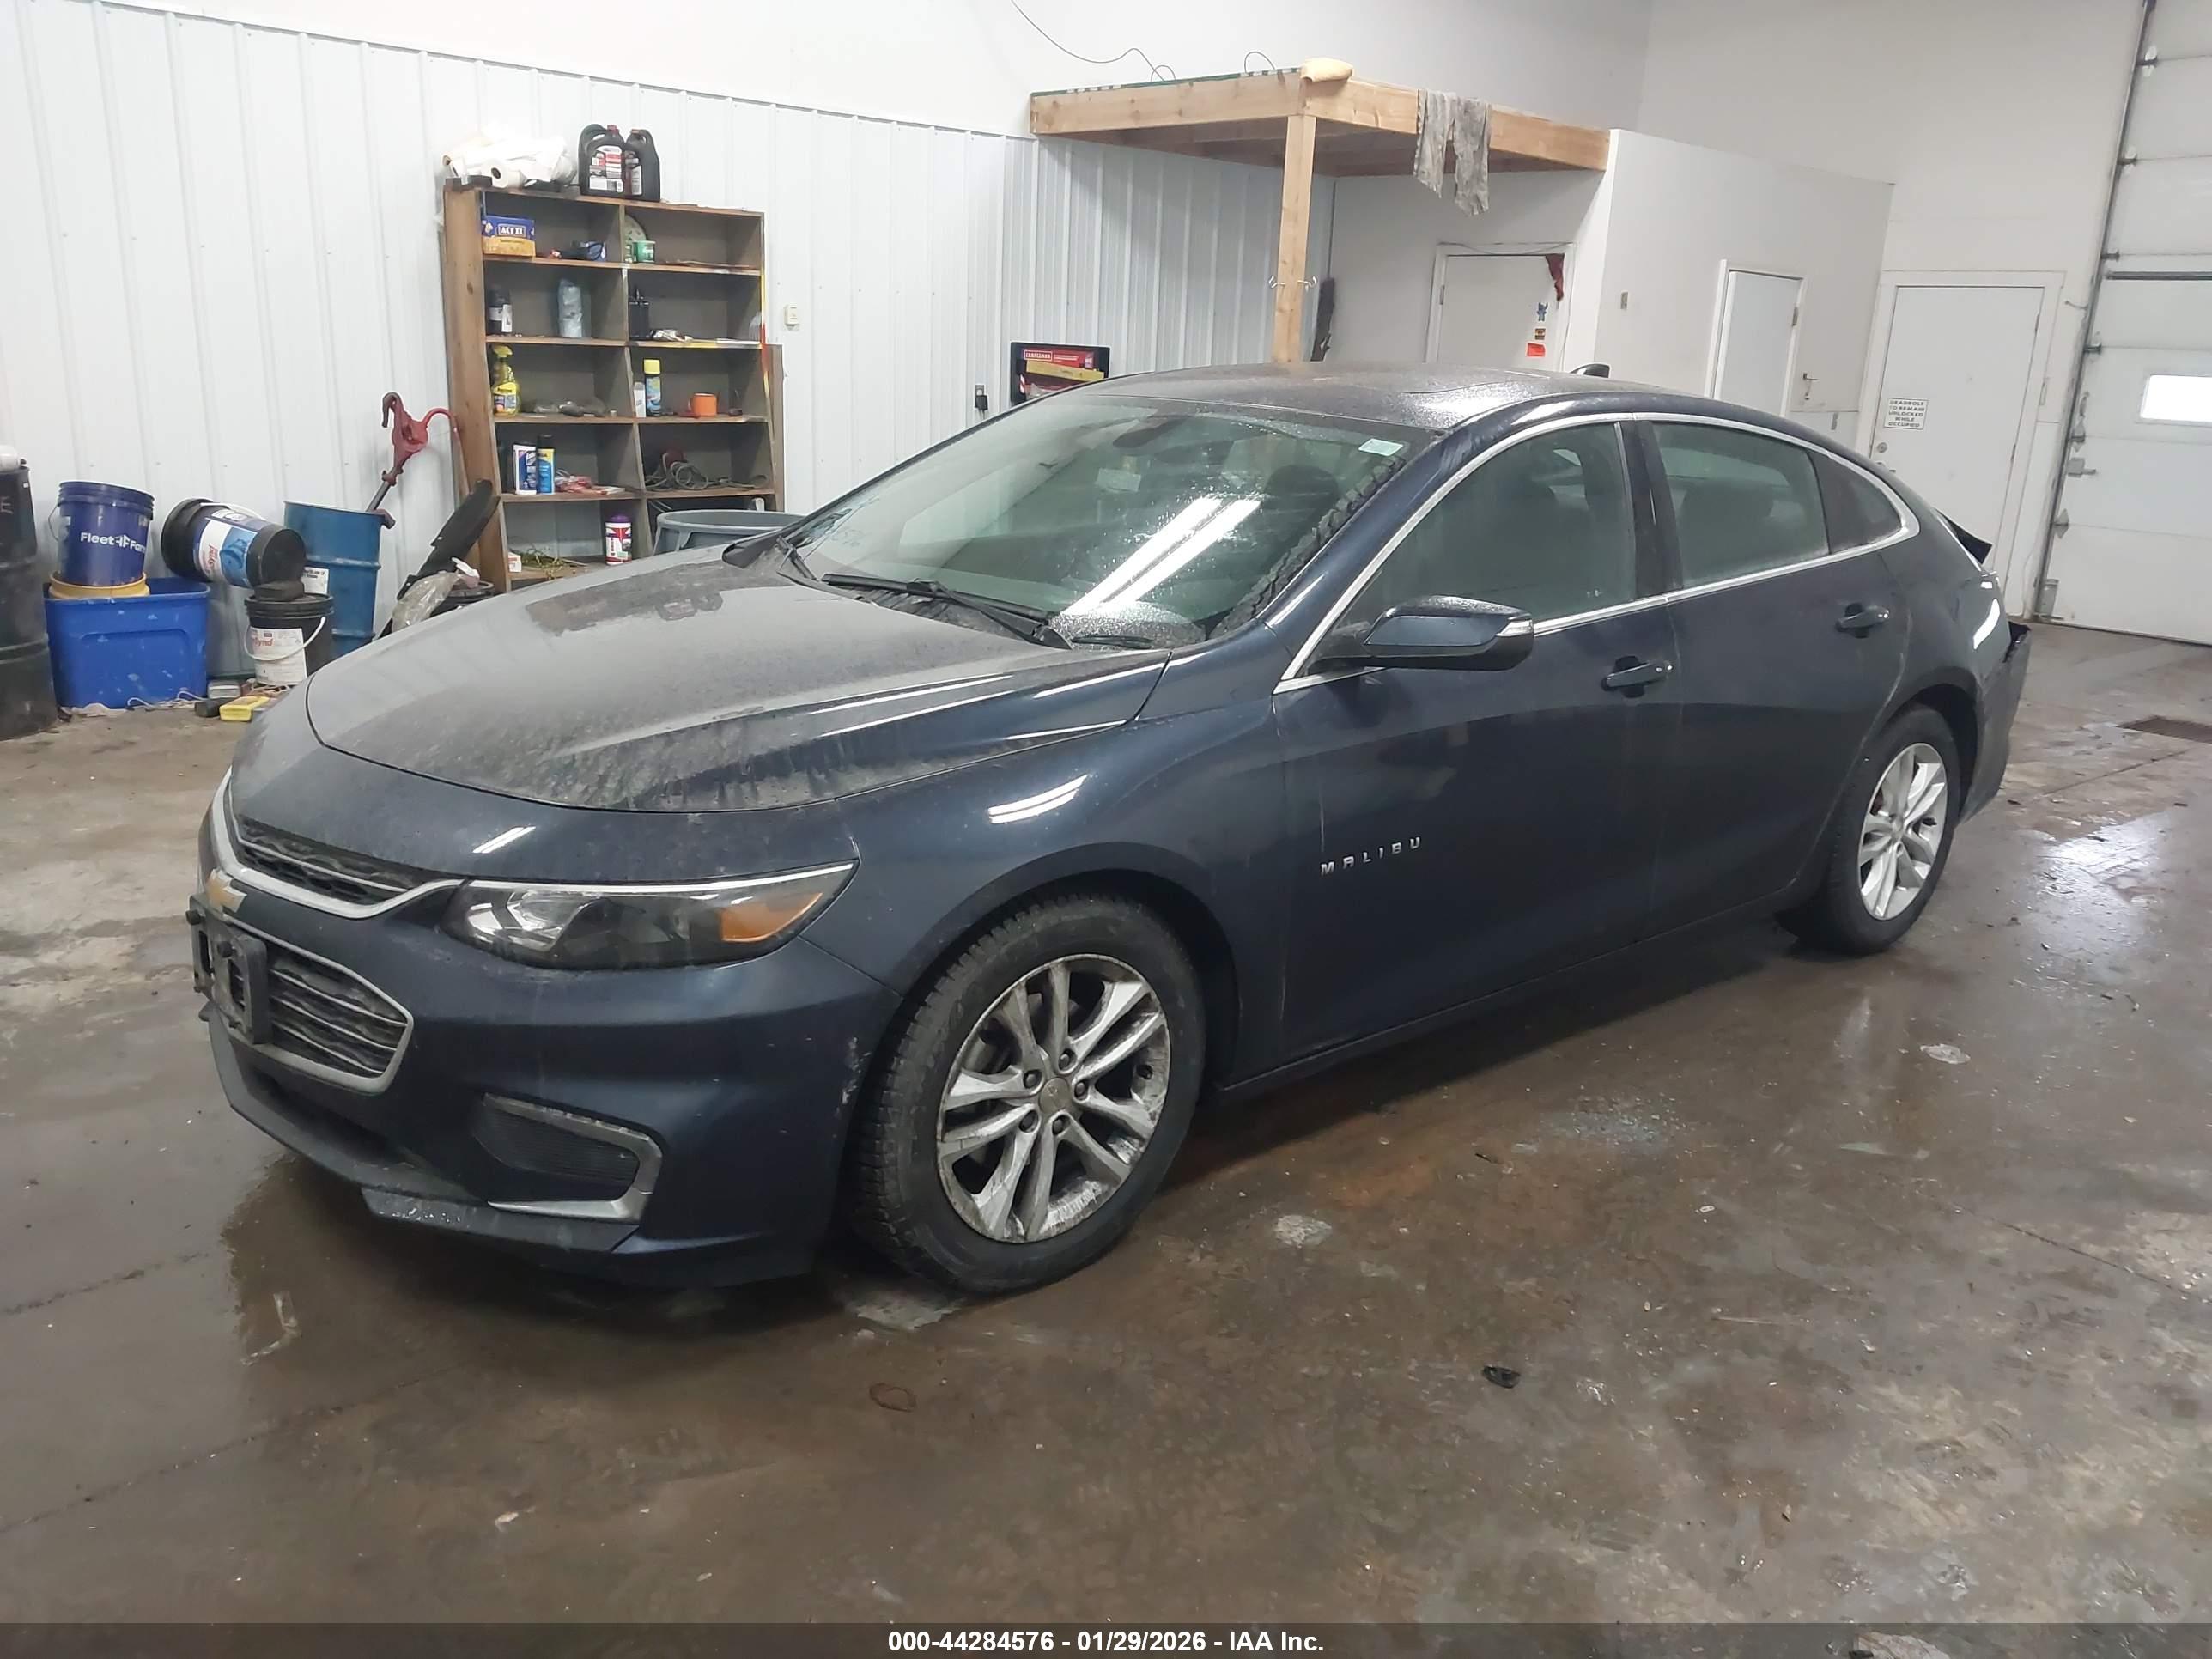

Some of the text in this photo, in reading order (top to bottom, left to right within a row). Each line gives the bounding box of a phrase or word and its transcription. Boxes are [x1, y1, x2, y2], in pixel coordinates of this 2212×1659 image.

[501, 226, 514, 235] ACT
[80, 532, 115, 546] Fleet
[1320, 836, 1422, 877] MALIBU
